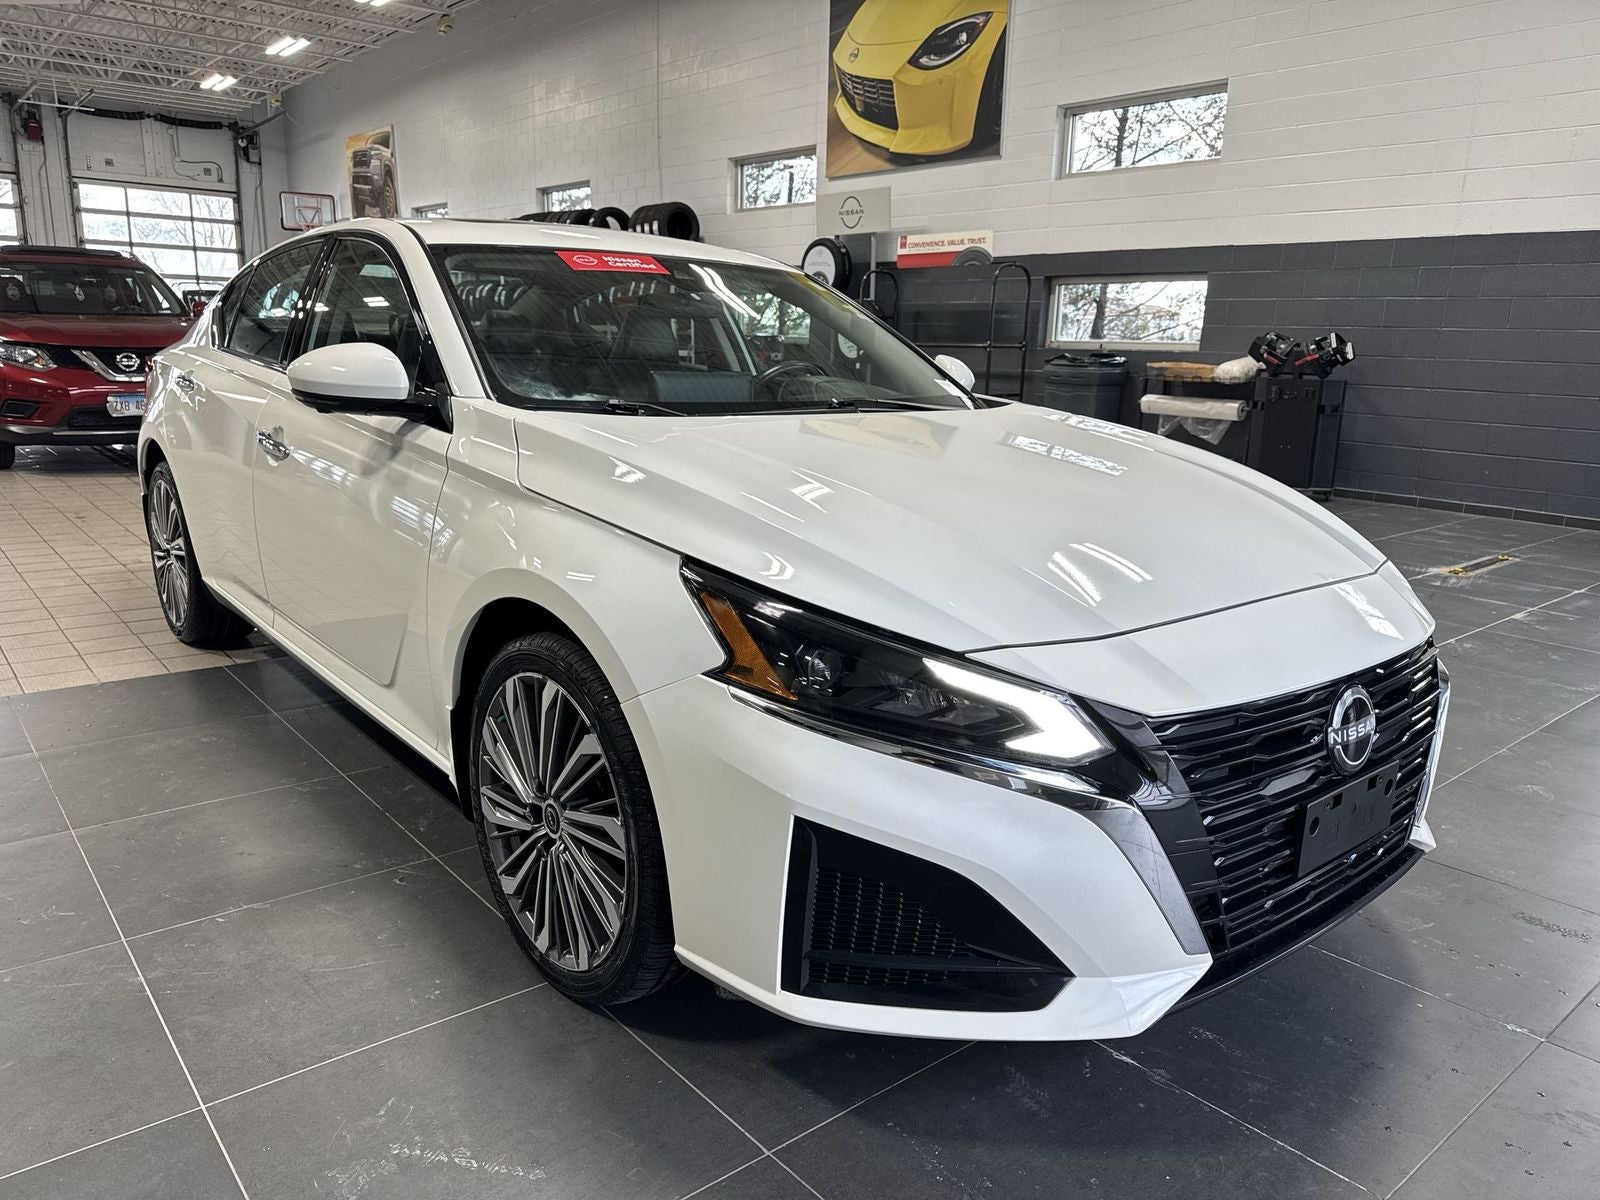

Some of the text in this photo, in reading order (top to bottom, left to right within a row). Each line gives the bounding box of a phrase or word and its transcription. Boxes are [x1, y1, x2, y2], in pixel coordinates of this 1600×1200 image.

[838, 208, 864, 216] NISSAN
[967, 237, 987, 245] TRUST.
[602, 255, 642, 263] Nissan
[608, 261, 657, 269] Certified
